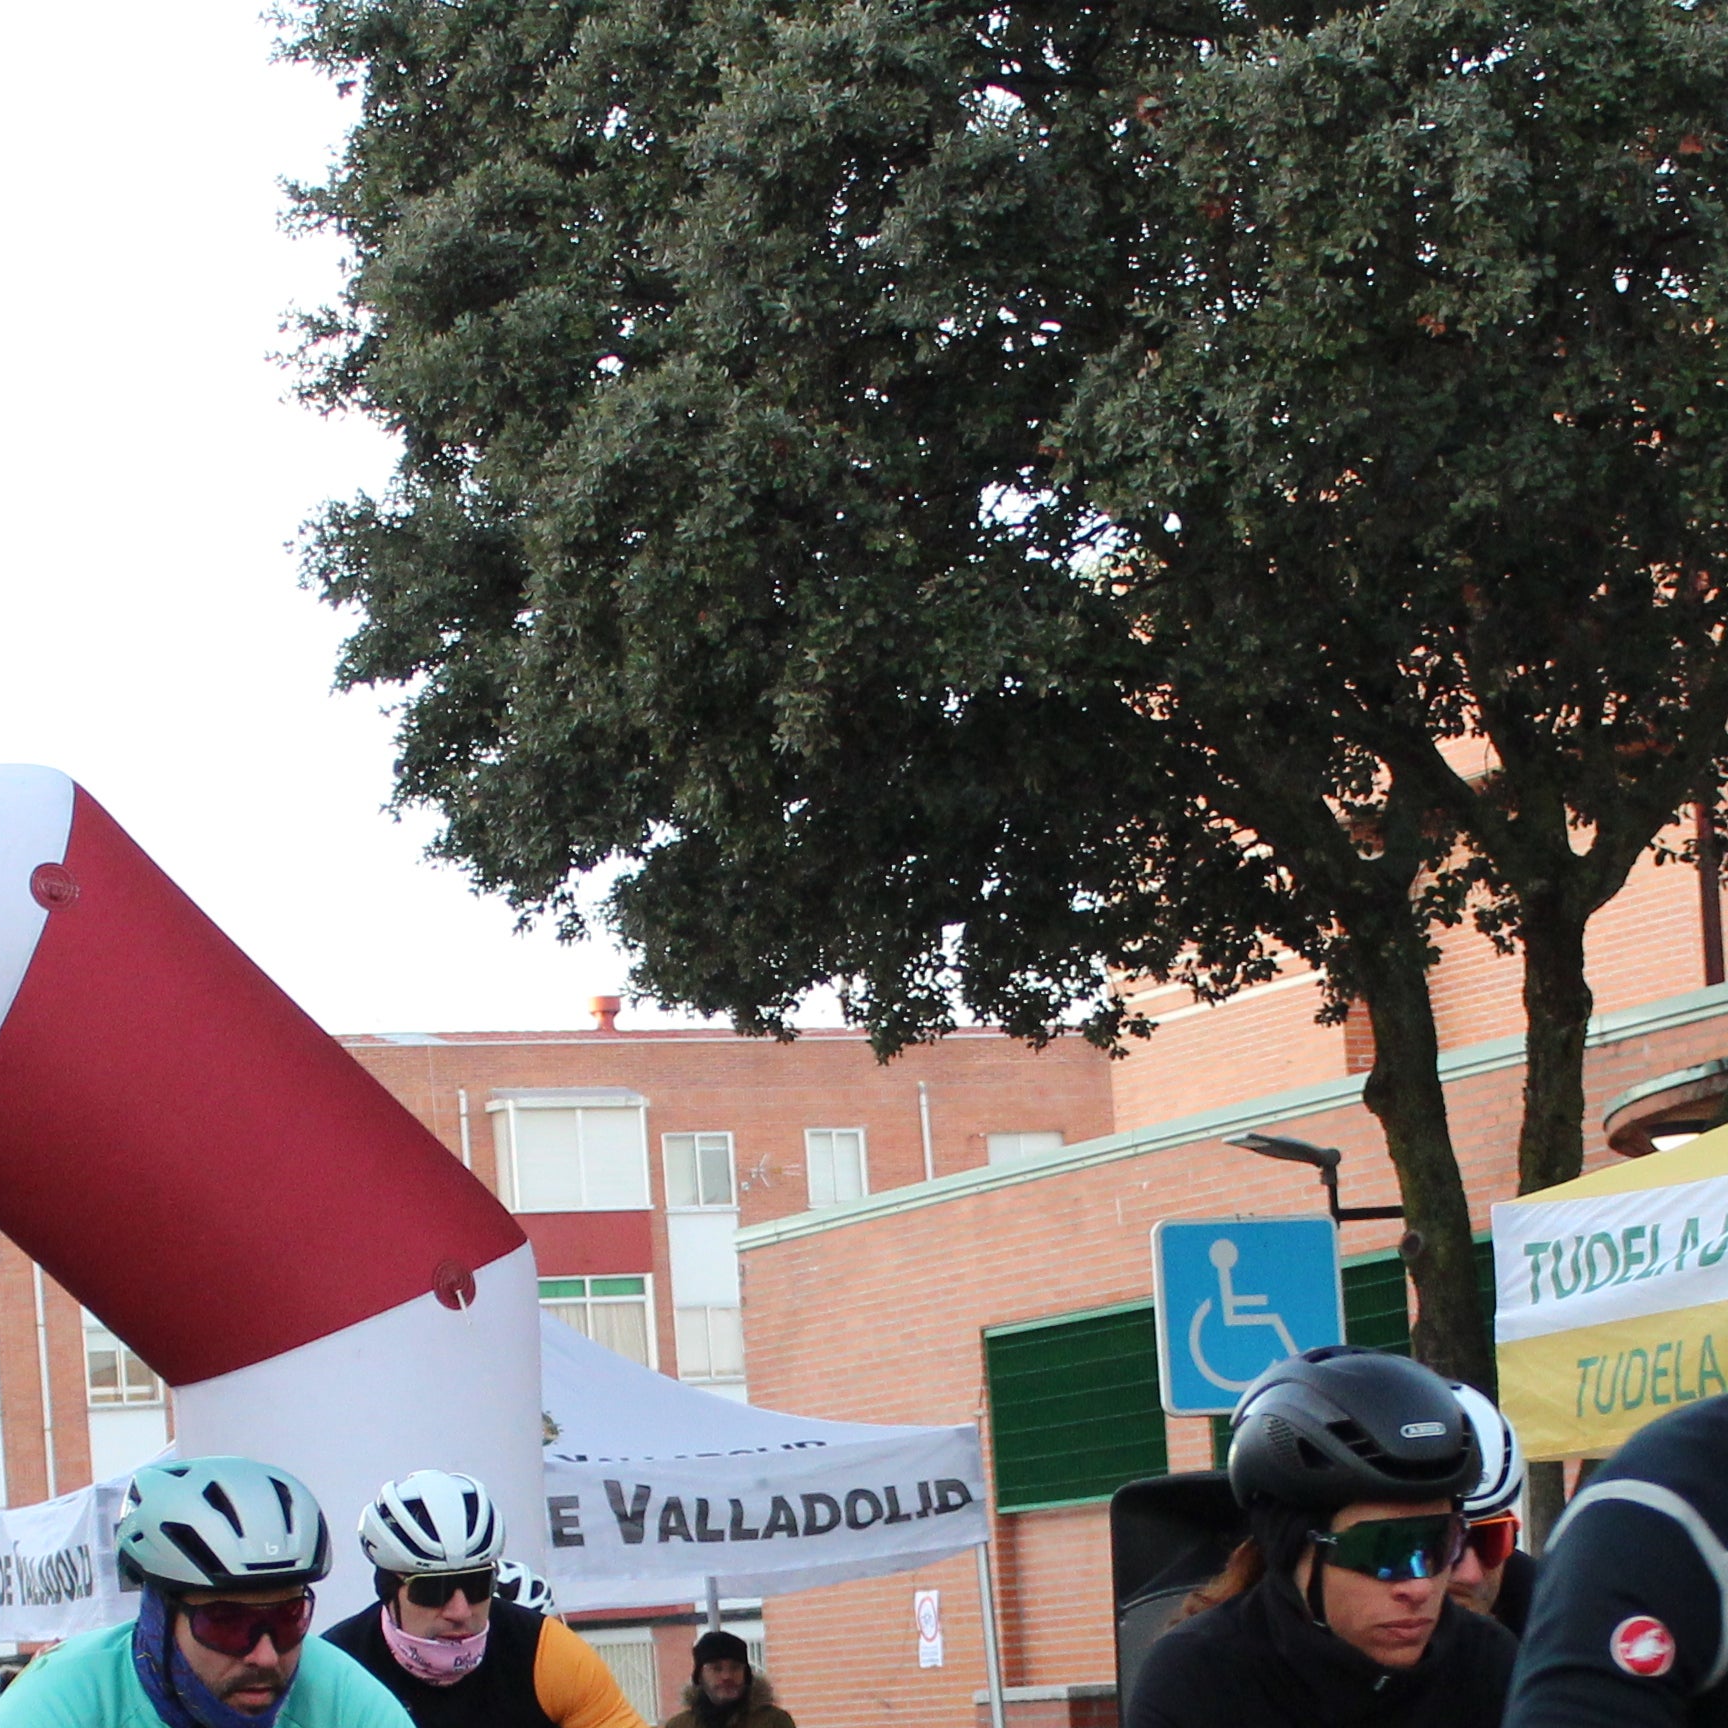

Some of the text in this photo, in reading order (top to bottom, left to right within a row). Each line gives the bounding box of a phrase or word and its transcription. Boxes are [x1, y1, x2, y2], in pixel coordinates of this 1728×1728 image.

[1523, 1216, 1700, 1305] TUDELA
[1576, 1334, 1728, 1418] TUDELA
[547, 1478, 973, 1549] E VALLADOLID
